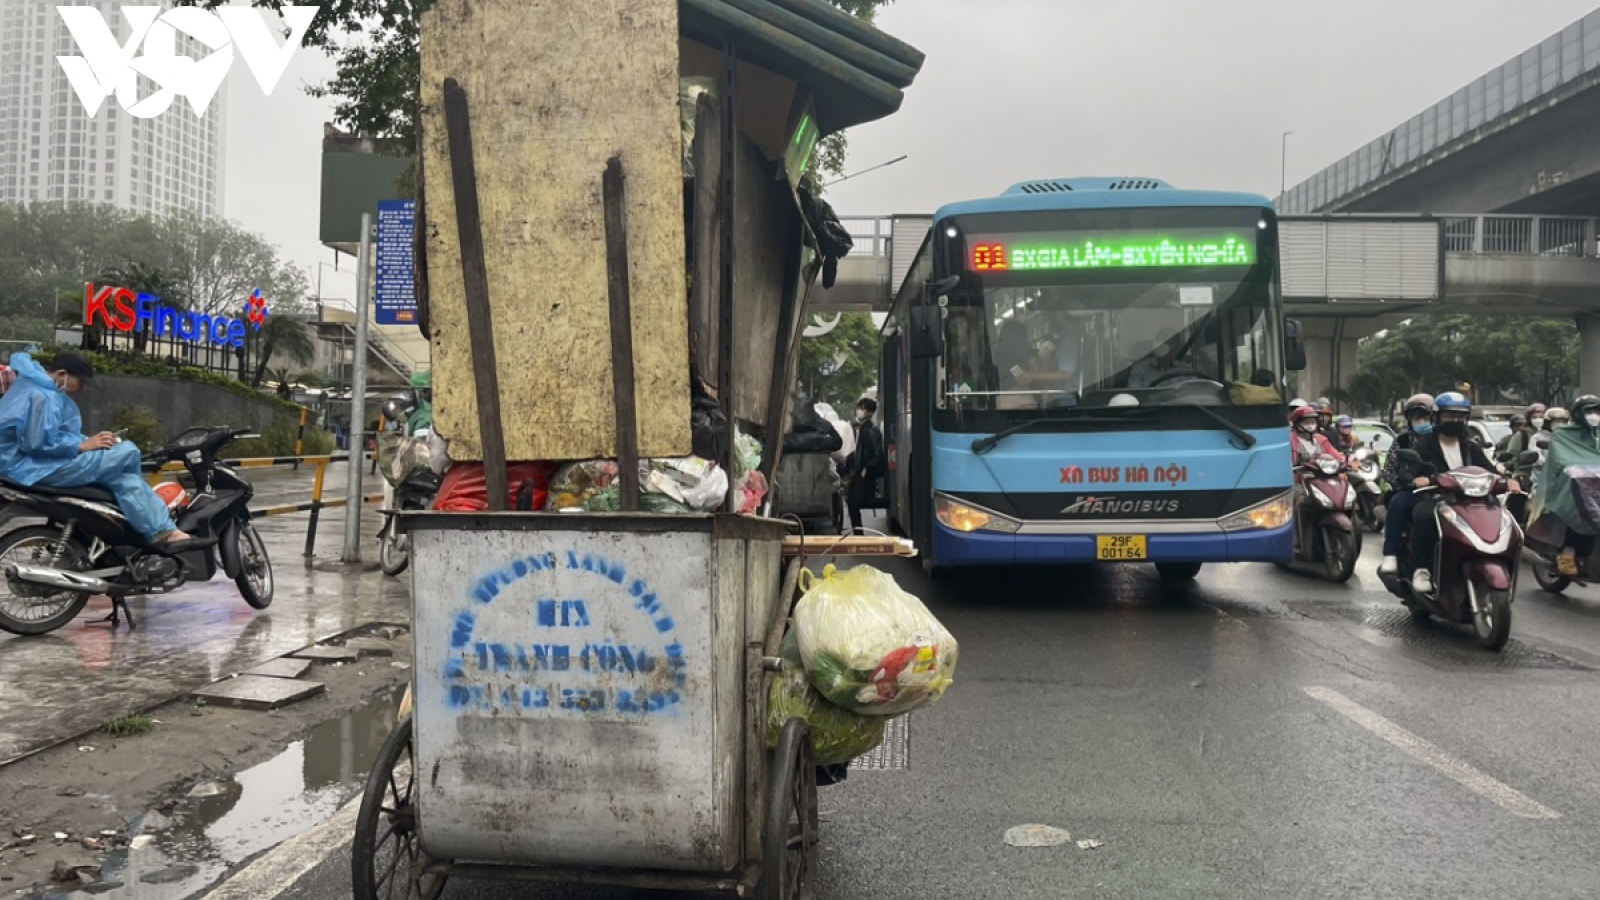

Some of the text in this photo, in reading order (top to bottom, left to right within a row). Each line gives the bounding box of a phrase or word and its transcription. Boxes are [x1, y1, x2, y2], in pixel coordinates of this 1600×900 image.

[974, 244, 1007, 270] 01
[84, 281, 246, 348] KSFinance
[1088, 466, 1120, 483] BUS
[1125, 462, 1149, 483] HÀ
[1153, 462, 1187, 486] NỘI
[1060, 496, 1180, 514] HANOIBUS
[1111, 536, 1133, 547] 29F
[1102, 547, 1141, 559] 001.64
